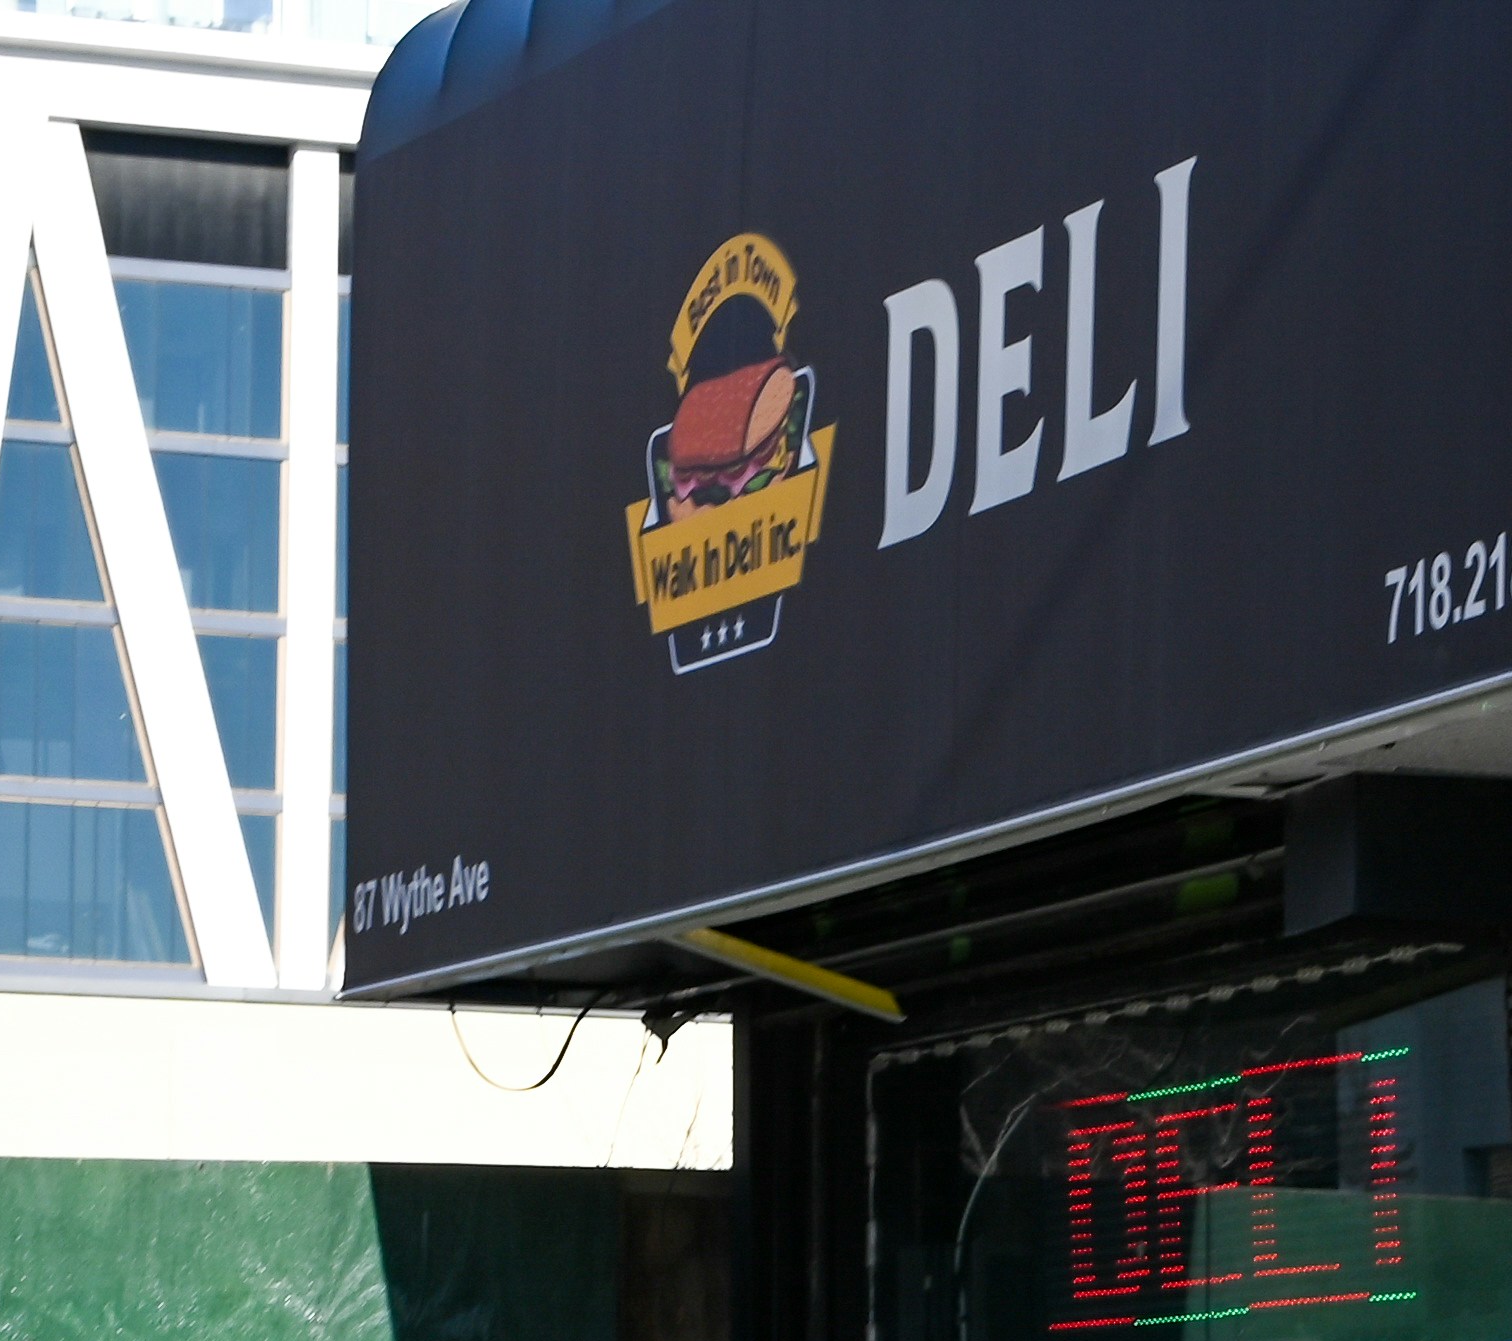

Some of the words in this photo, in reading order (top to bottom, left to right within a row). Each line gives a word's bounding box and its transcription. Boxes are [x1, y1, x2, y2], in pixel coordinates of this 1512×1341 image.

[688, 262, 722, 337] Best
[724, 248, 739, 288] in
[744, 243, 781, 306] Town
[877, 155, 1198, 550] DELI
[651, 545, 698, 600] Walk
[724, 519, 764, 580] Deli
[353, 878, 378, 934] 87
[380, 864, 446, 936] Wythe
[448, 854, 490, 909] Ave
[1068, 1078, 1404, 1300] DELI
